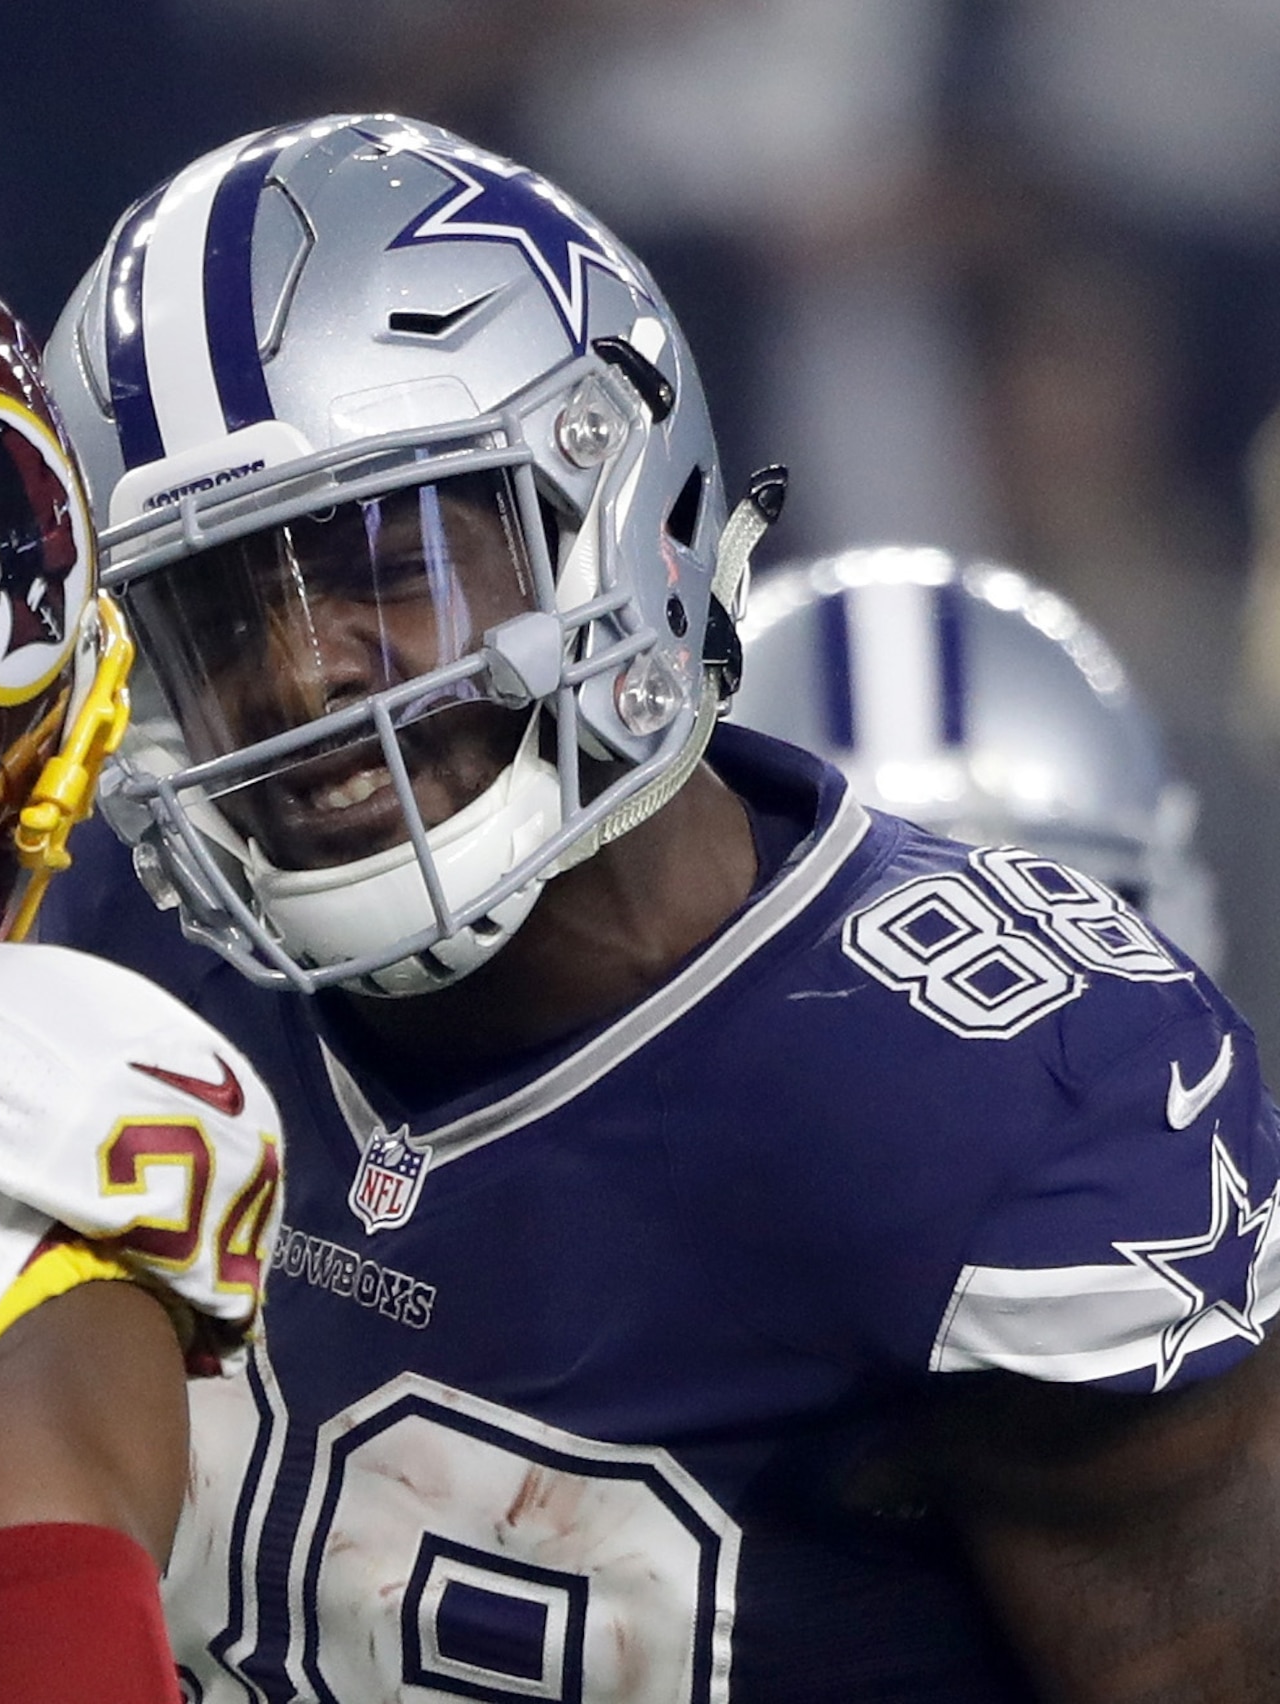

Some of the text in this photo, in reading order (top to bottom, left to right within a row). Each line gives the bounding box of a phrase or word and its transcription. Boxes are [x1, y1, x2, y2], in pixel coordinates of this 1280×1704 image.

[841, 845, 1195, 1040] 88
[97, 1113, 283, 1304] 24
[358, 1168, 405, 1216] NFL
